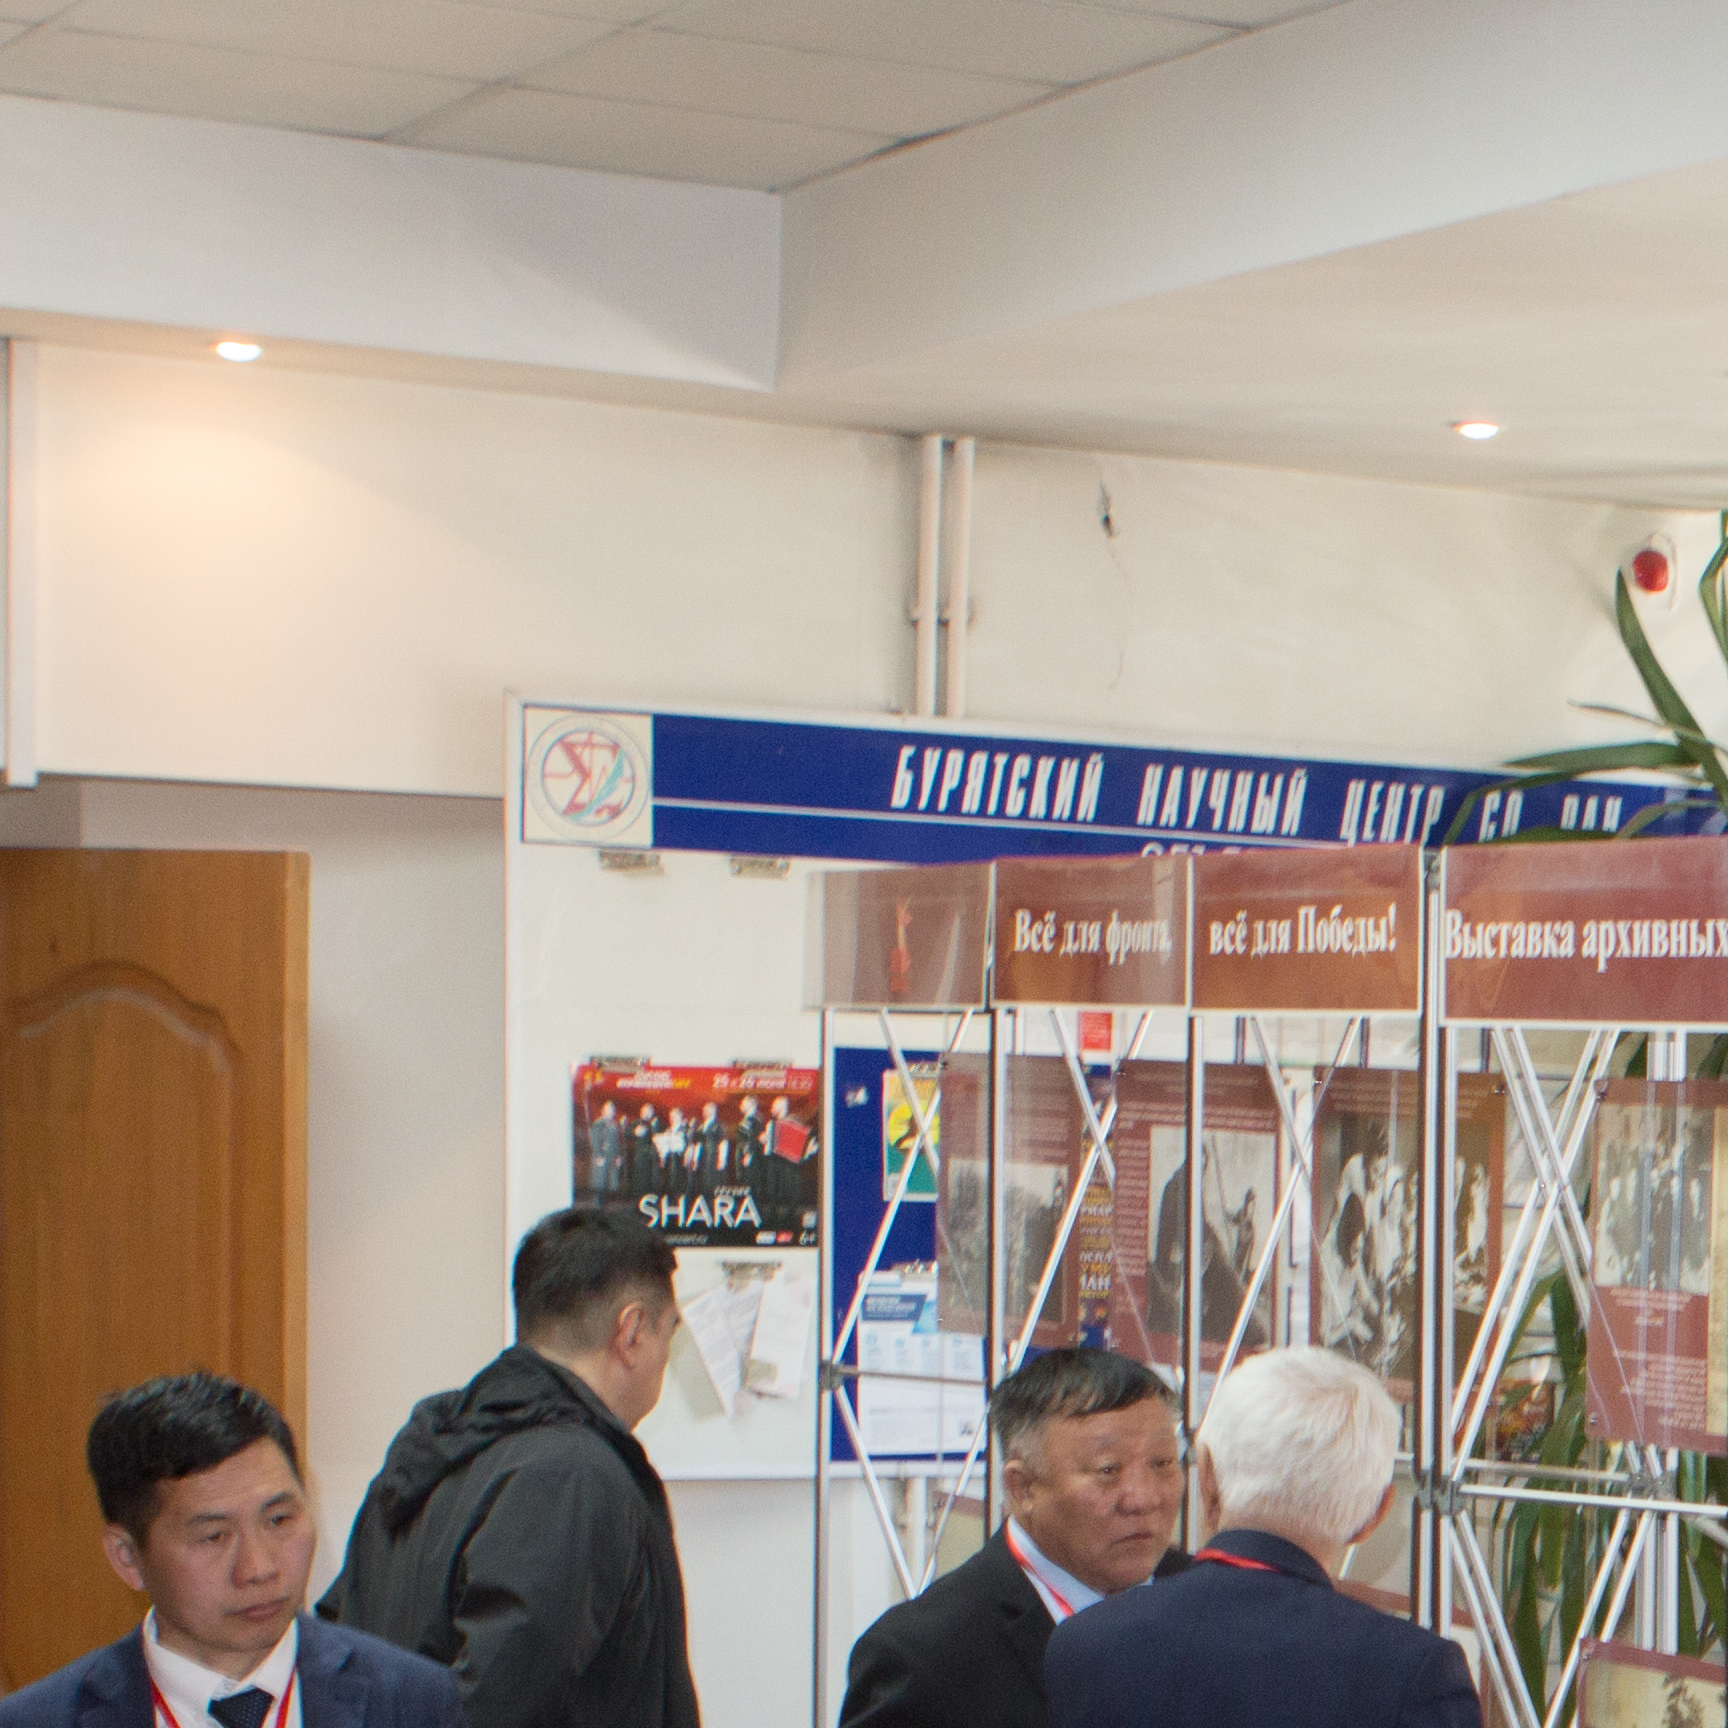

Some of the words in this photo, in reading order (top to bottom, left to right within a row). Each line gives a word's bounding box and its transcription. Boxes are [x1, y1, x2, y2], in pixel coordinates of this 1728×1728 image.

[890, 745, 1104, 822] БУРЯТСКИЙ
[1136, 763, 1309, 836] НАУЧНЫЙ
[1339, 779, 1446, 848] ЦЕНТР
[1478, 789, 1524, 843] СО
[1014, 909, 1055, 952] Всё
[1060, 920, 1101, 957] для
[1209, 909, 1248, 955] всё
[1250, 919, 1292, 960] для
[1297, 902, 1397, 958] Победы!
[1445, 909, 1575, 958] Выставка
[638, 1194, 763, 1228] SHARA
